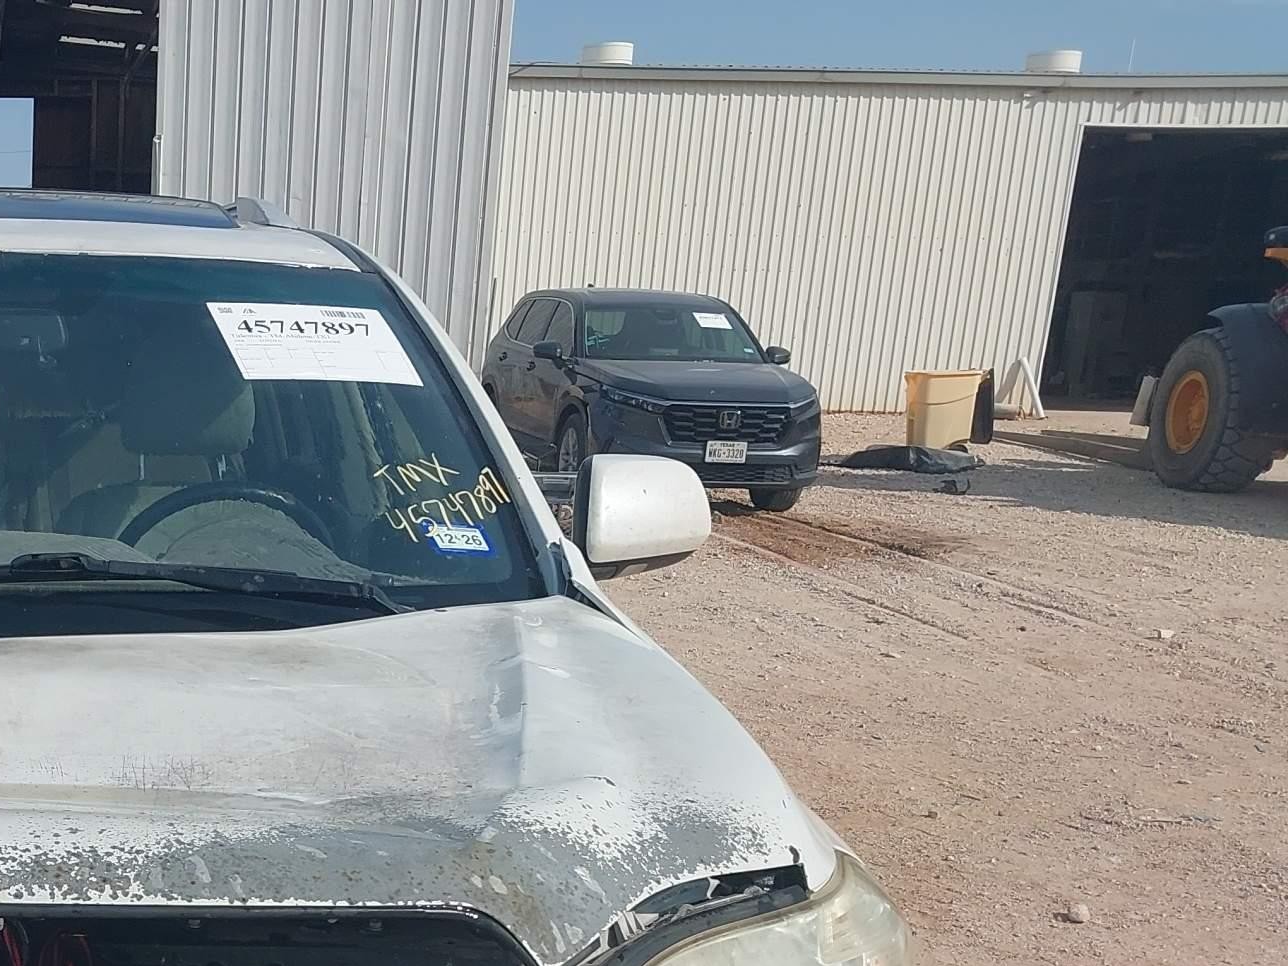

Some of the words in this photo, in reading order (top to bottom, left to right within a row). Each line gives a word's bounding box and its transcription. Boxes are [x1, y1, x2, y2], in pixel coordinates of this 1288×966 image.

[237, 319, 369, 337] 45747897
[373, 452, 460, 495] TMX
[385, 466, 511, 543] 45747897
